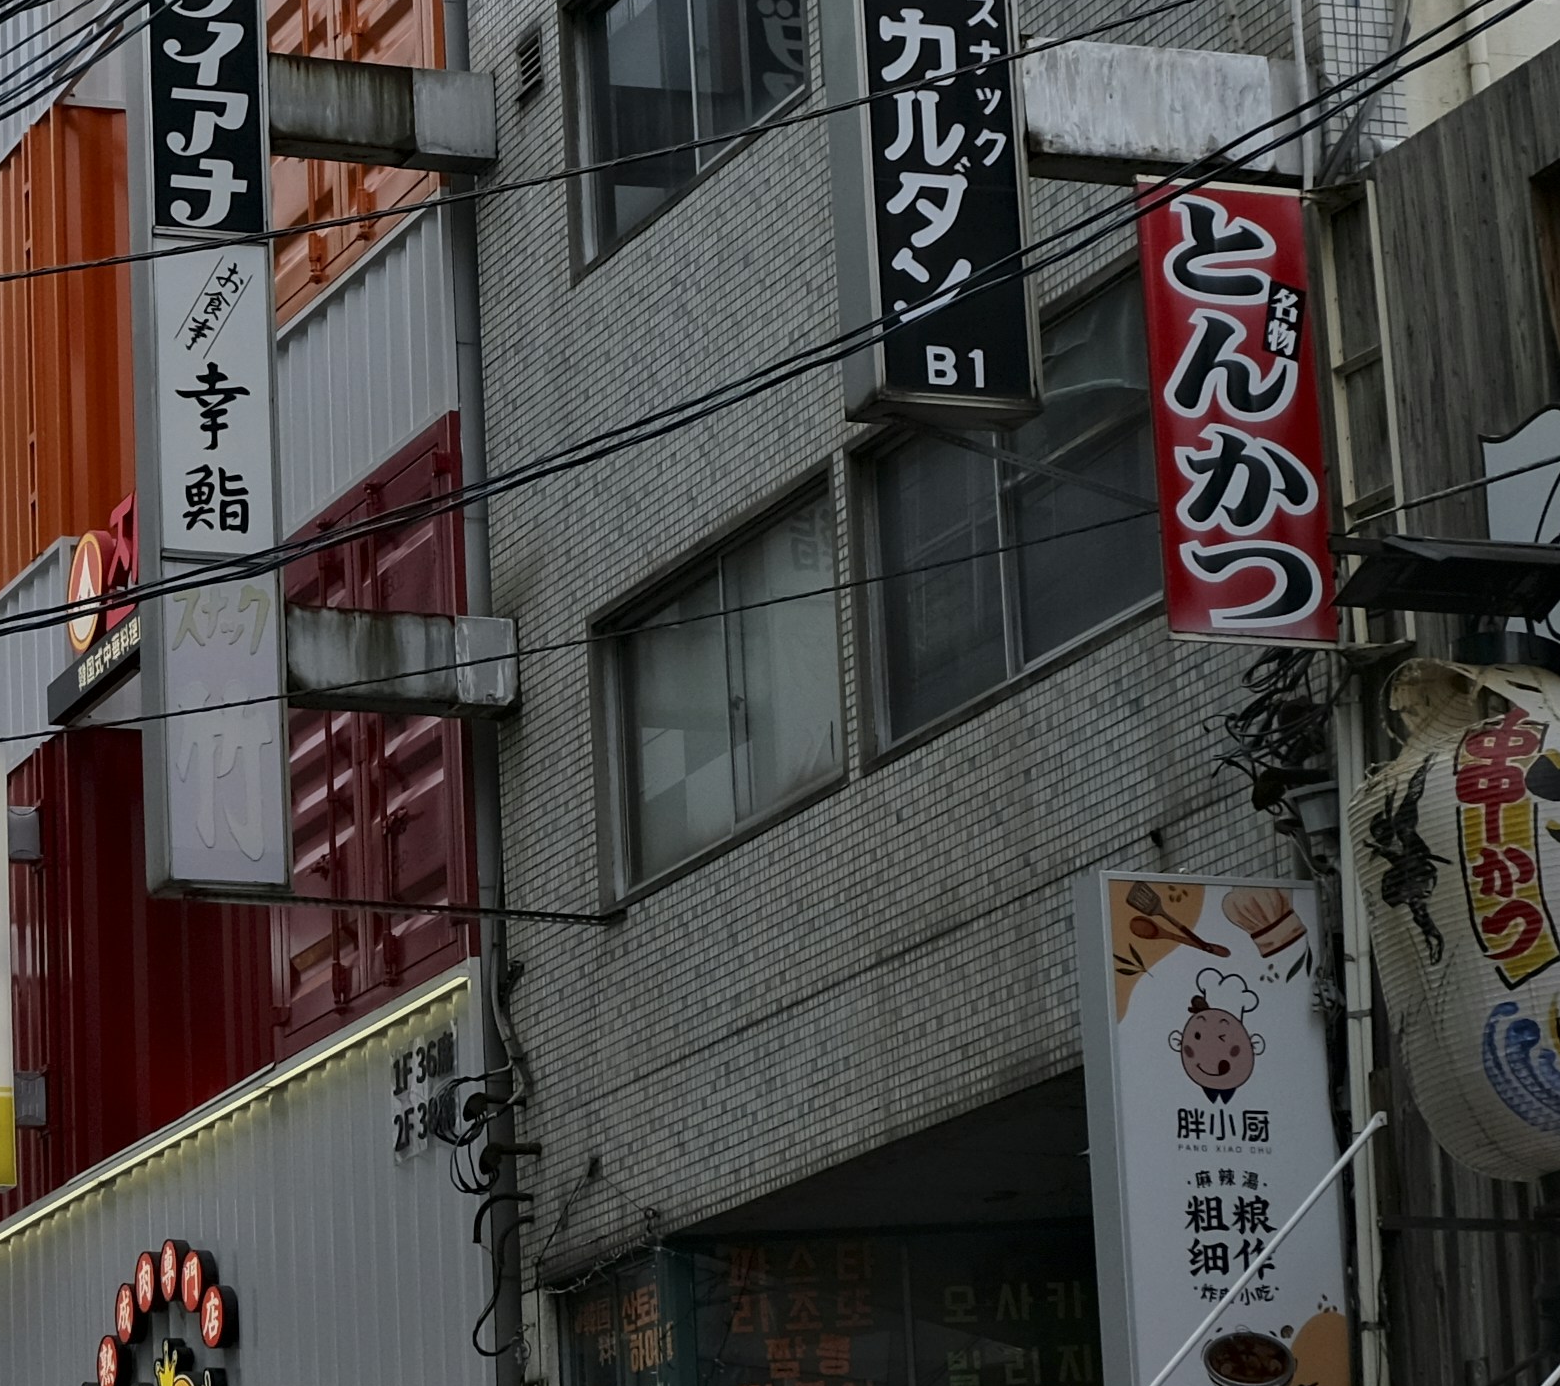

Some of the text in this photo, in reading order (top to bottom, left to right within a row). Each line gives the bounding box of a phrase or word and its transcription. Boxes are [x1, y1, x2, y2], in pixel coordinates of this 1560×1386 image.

[879, 8, 973, 326] カルダン
[182, 263, 245, 350] お食事
[1268, 289, 1301, 359] 名物
[925, 344, 987, 389] B1
[176, 362, 251, 534] 幸鮨
[1164, 195, 1324, 629] とんかつ
[1456, 708, 1544, 960] 串かつ
[1177, 1108, 1270, 1142] 胖小厨
[1185, 1196, 1277, 1235] 粗粮
